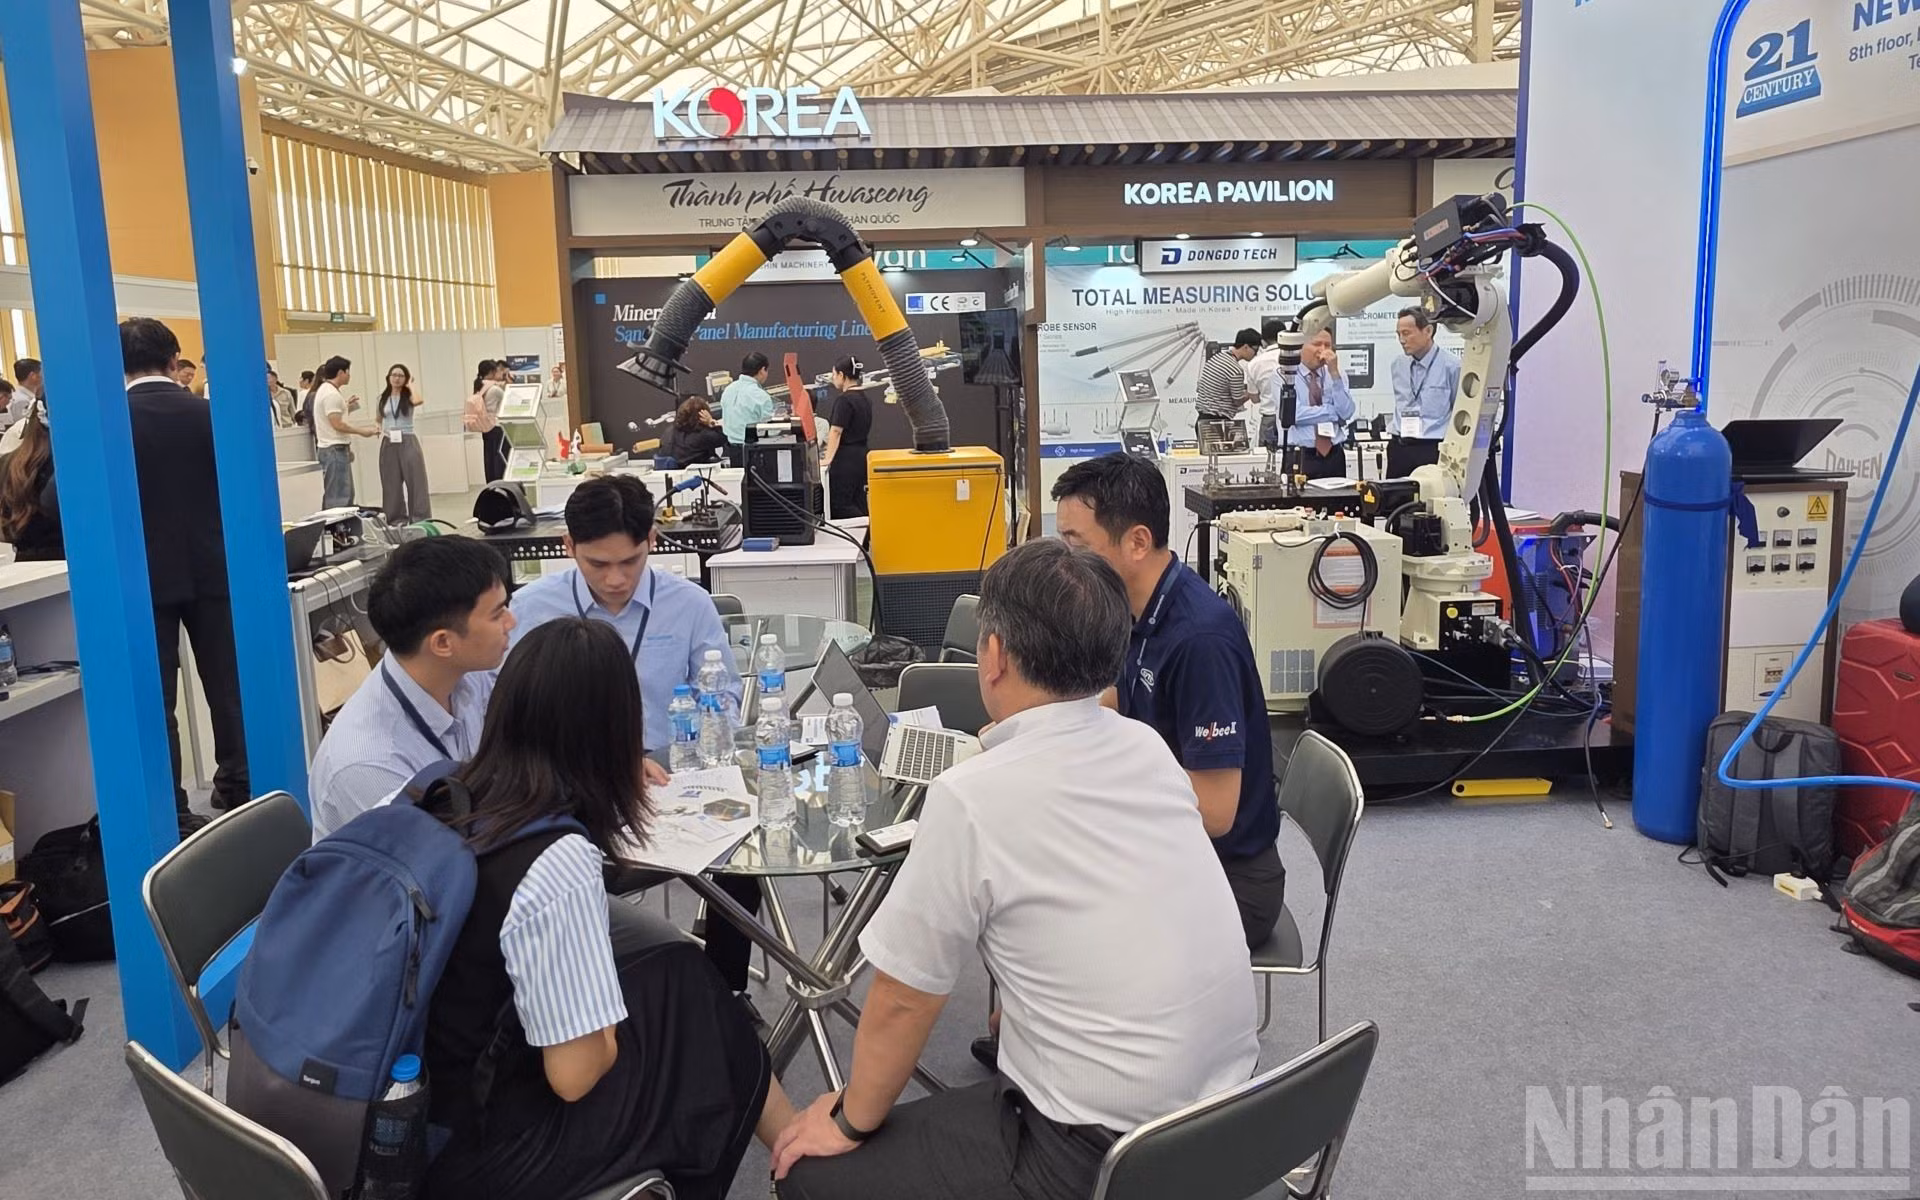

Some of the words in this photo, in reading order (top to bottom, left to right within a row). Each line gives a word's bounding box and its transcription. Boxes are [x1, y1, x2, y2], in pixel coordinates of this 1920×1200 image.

[1744, 18, 1818, 81] 21
[1849, 43, 1873, 62] 8th
[1877, 33, 1913, 53] floor,
[1743, 68, 1815, 104] CENTURY
[652, 86, 872, 138] KOREA
[663, 178, 743, 213] Thành
[1124, 182, 1212, 205] KOREA
[1217, 179, 1334, 203] PAVILION
[699, 217, 735, 228] TRUNG
[870, 211, 901, 224] QUỐC
[780, 261, 829, 269] MACHINERY
[1187, 250, 1240, 261] DONGDO
[1244, 248, 1278, 260] TECH
[1072, 288, 1137, 306] TOTAL
[1143, 285, 1259, 305] MEASURING
[1265, 283, 1314, 301] SOLU
[1106, 309, 1124, 317] High
[1175, 306, 1198, 314] Made
[733, 321, 838, 340] Manufacturing
[1037, 323, 1060, 332] ROBE
[1062, 322, 1097, 331] SENSOR
[1825, 447, 1883, 480] DAIHEN
